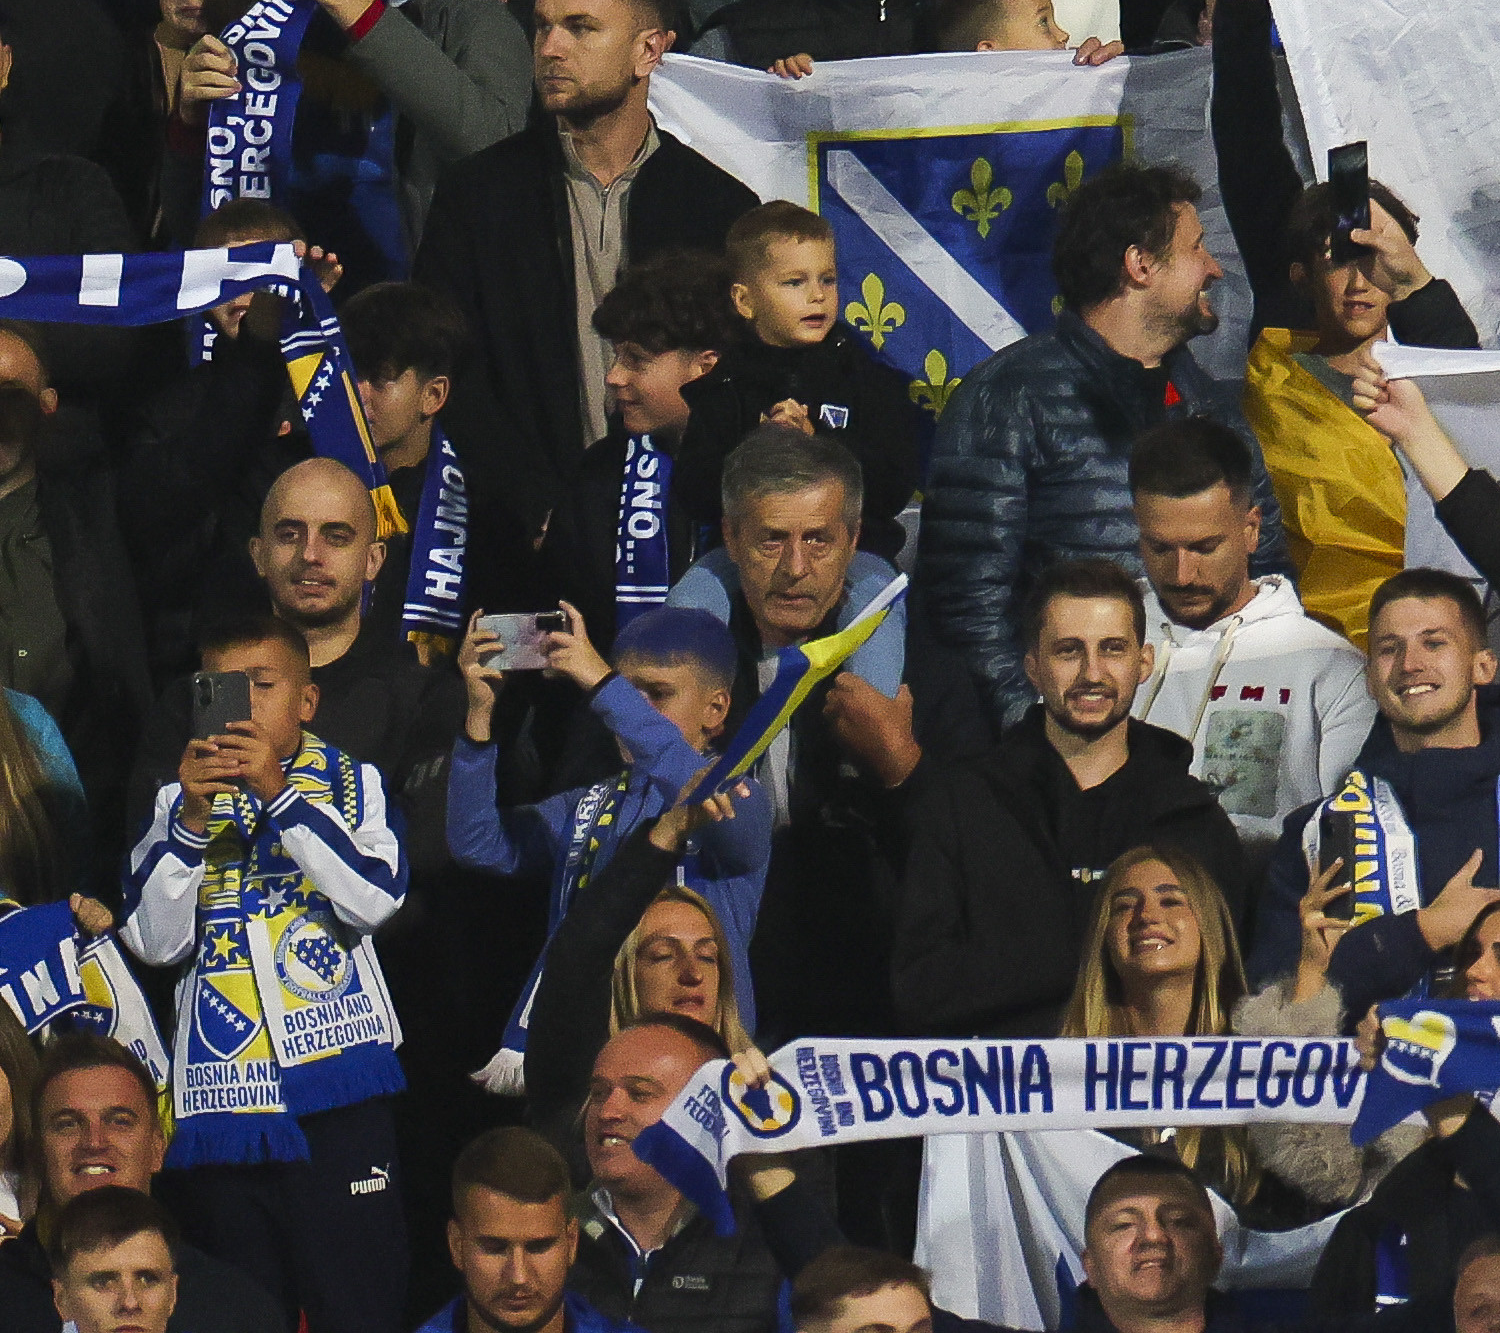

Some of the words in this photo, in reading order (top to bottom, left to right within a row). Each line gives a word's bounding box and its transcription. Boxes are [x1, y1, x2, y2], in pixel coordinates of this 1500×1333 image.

[280, 1015, 388, 1062] HERZEGOVINA
[281, 1010, 343, 1037] BOSNIA
[346, 994, 372, 1018] AND
[850, 1045, 1053, 1122] BOSNIA
